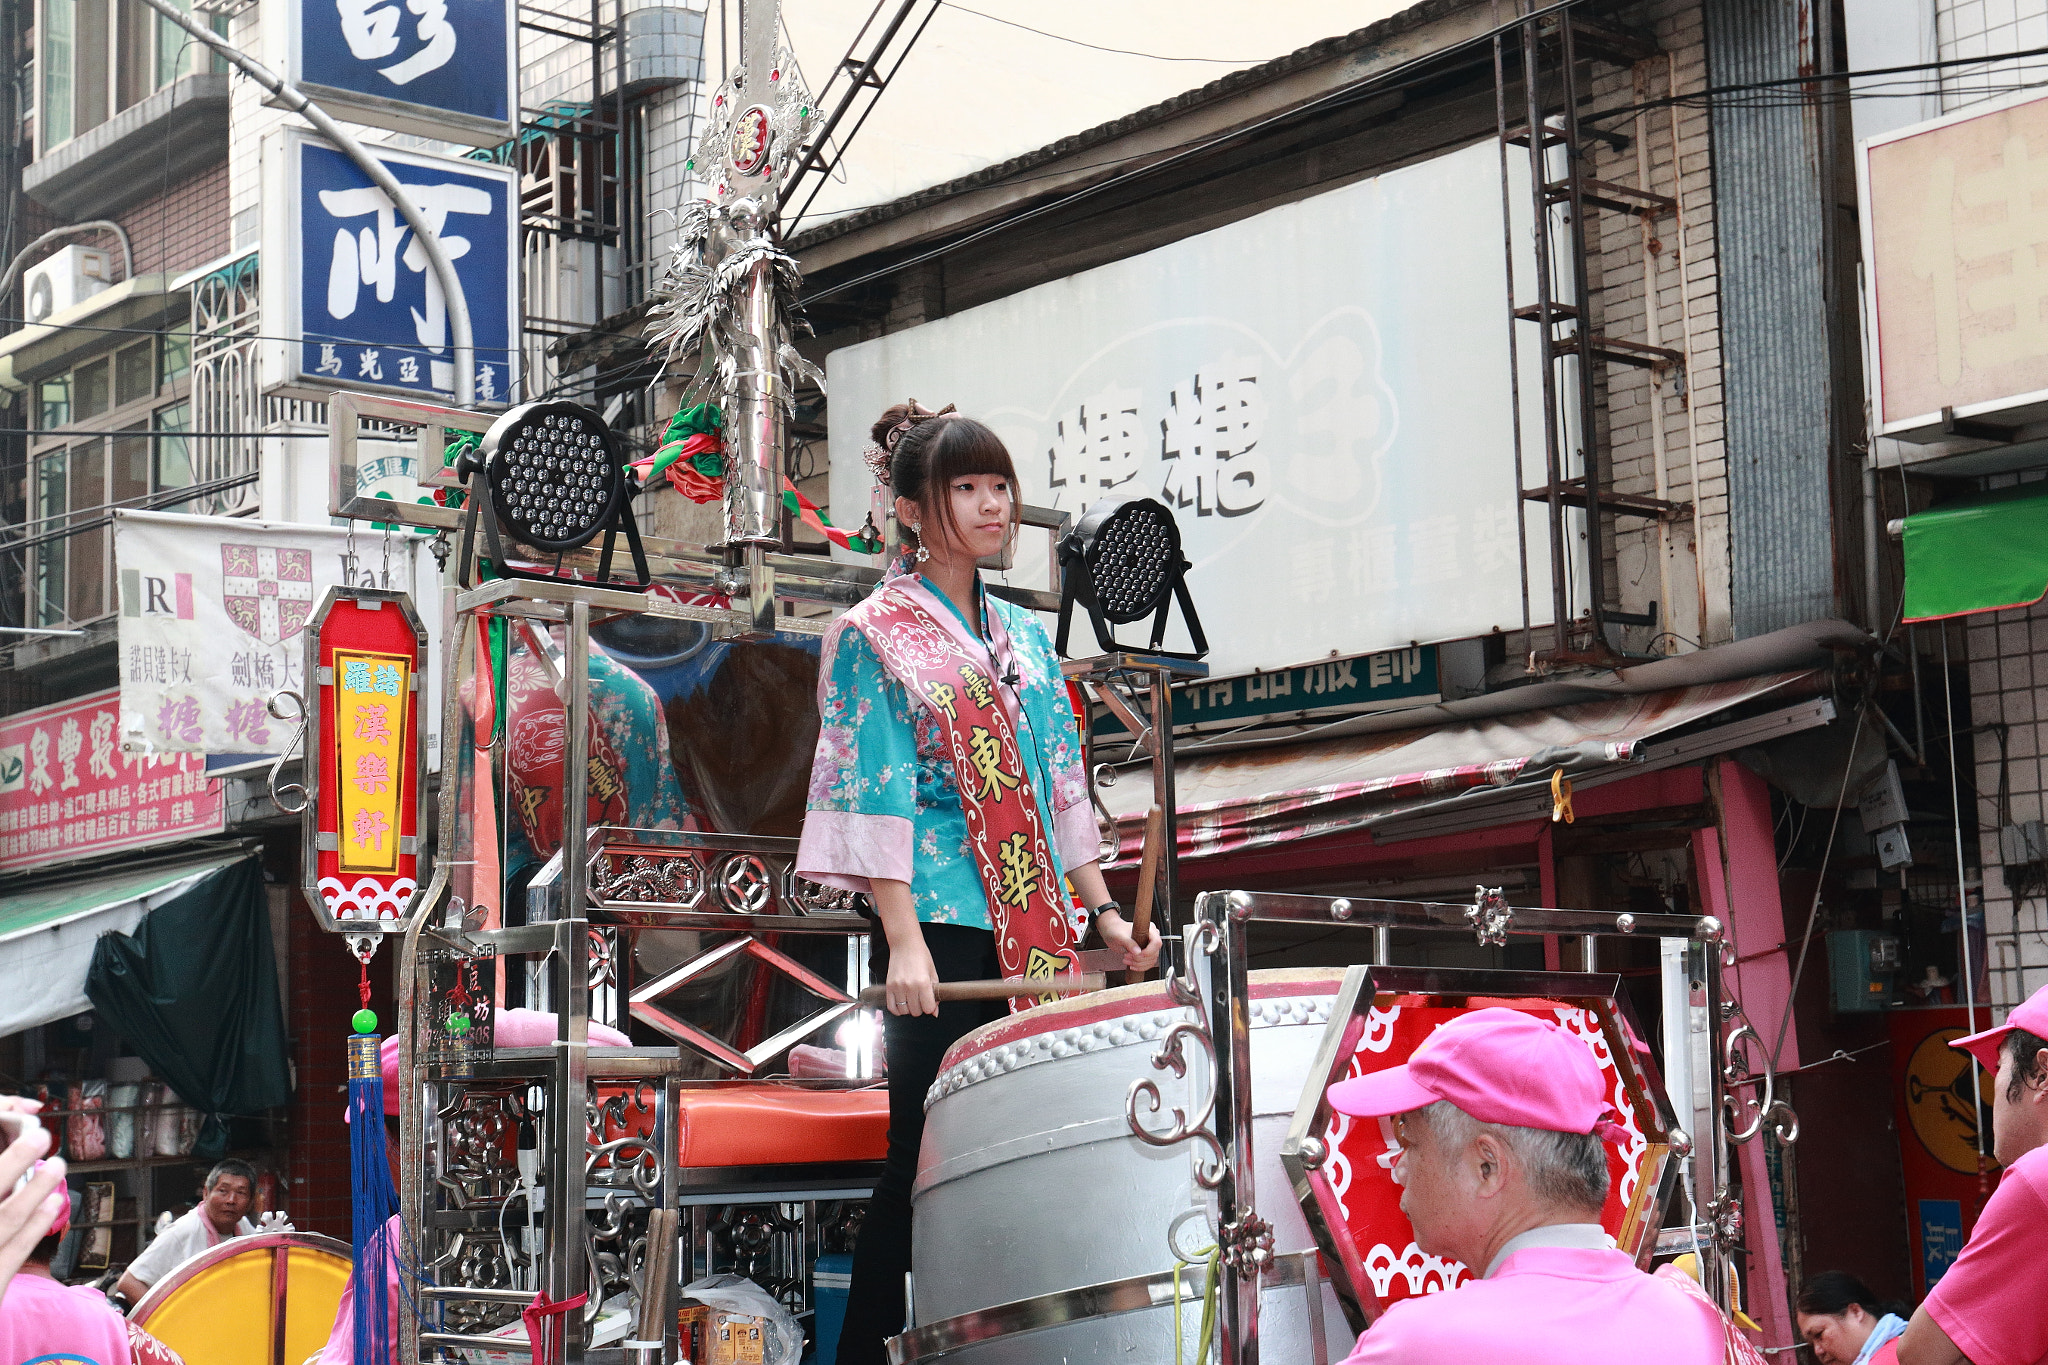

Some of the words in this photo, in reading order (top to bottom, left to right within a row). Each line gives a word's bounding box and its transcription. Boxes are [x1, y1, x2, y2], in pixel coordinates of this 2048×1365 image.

[144, 576, 174, 614] R
[231, 651, 304, 690] 劍橋大
